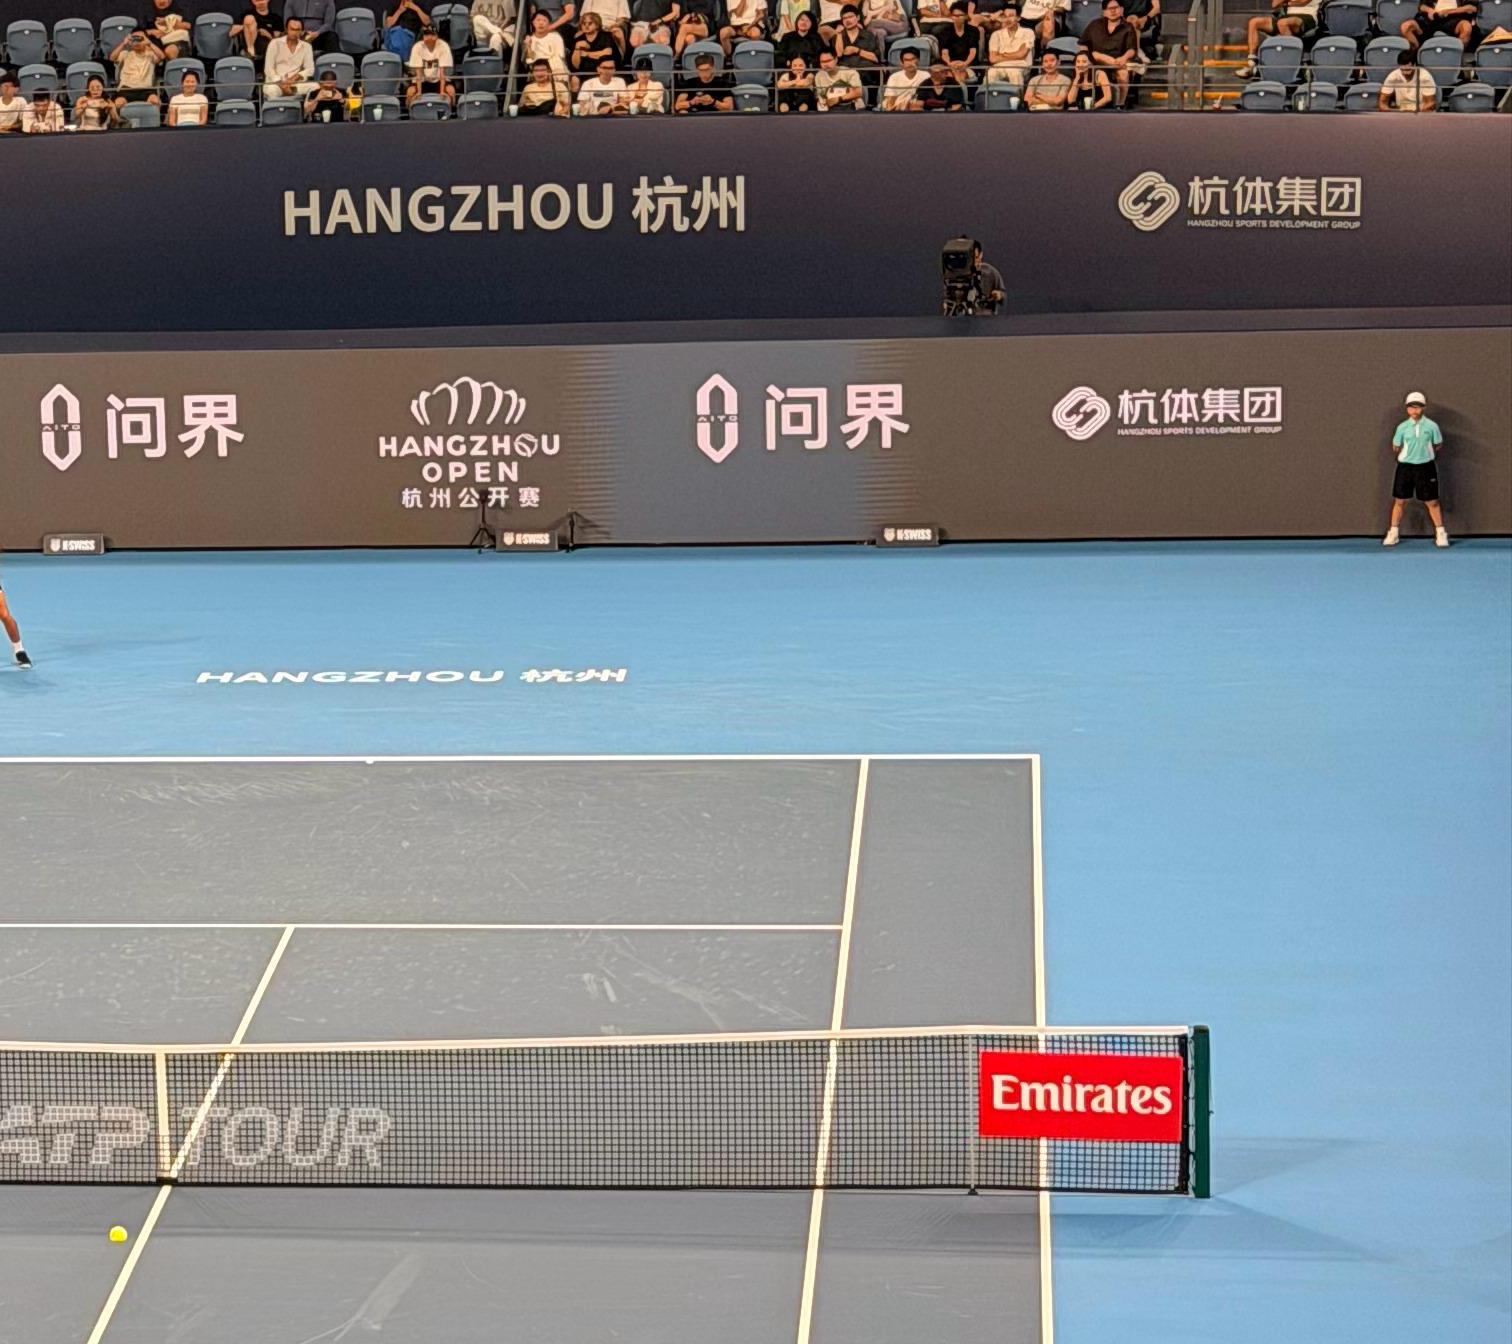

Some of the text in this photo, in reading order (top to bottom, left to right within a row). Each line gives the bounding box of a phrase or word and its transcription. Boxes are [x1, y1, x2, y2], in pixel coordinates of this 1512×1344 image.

[284, 175, 747, 237] HANGZHOU 杭州
[1188, 175, 1362, 217] 杭体集团
[1187, 219, 1361, 230] HANGZHOU SPORTS DEVELOPMENT GROUP
[765, 383, 912, 452] 问界
[1118, 387, 1282, 425] 杭体集团
[106, 393, 245, 459] 问界
[378, 432, 560, 458] HANGZHOU
[421, 461, 519, 483] OPEN
[401, 486, 541, 509] 杭州公开赛
[195, 668, 629, 684] HANGZHOU 杭州
[991, 1074, 1173, 1115] Emirates
[180, 1104, 391, 1167] TOUR
